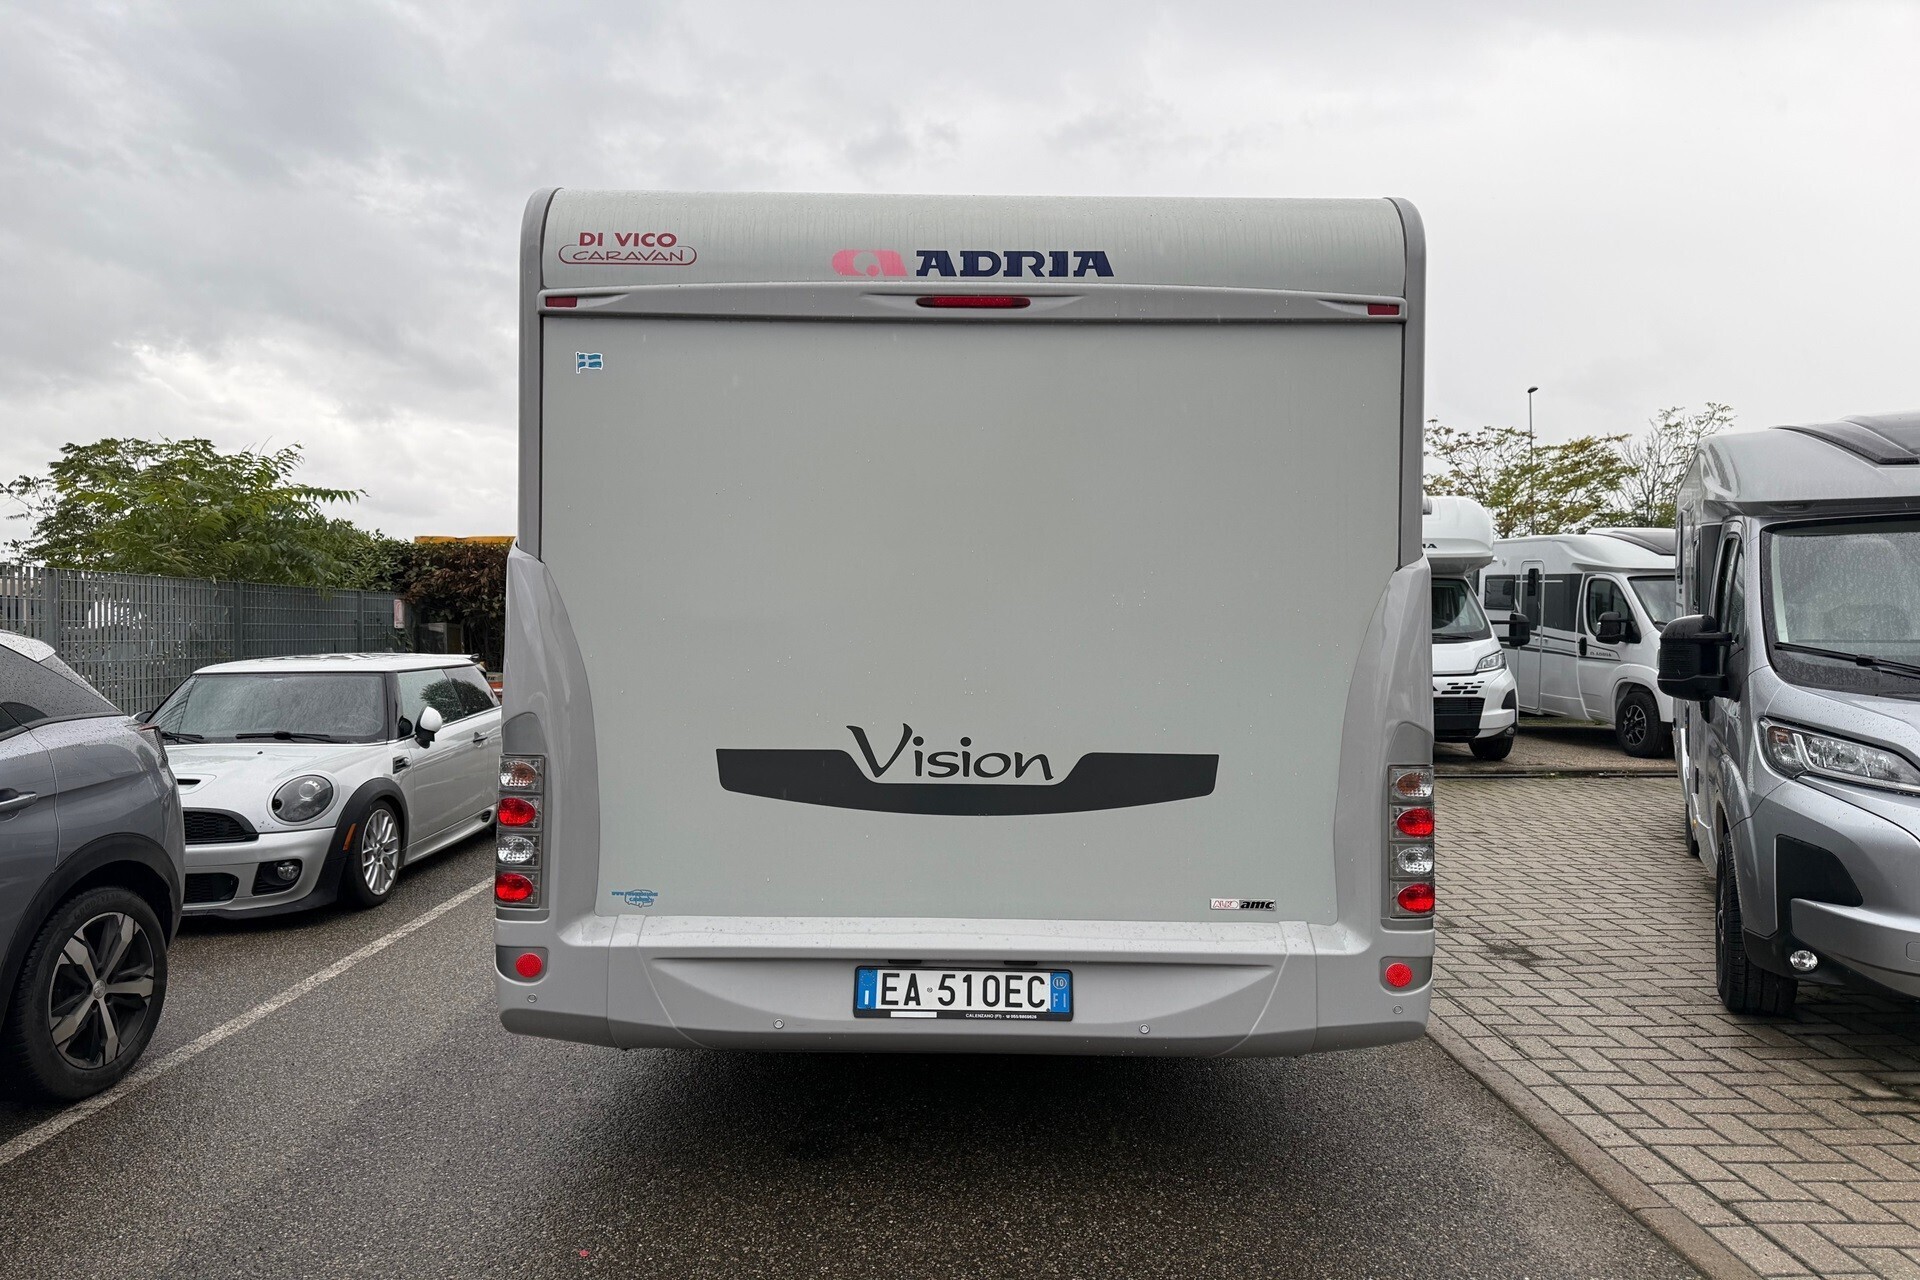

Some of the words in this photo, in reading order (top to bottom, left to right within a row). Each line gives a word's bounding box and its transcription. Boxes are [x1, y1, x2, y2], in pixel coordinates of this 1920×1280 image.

[579, 232, 603, 247] DI
[614, 232, 677, 248] VICO
[572, 249, 684, 262] CARAVAN
[916, 250, 1115, 278] ADRIA
[845, 722, 1055, 781] Vision
[1240, 901, 1274, 910] amc
[1056, 978, 1064, 987] 10
[864, 990, 870, 1005] I
[880, 972, 922, 1006] EA
[937, 973, 1046, 1009] 510EC
[1053, 993, 1067, 1008] FI
